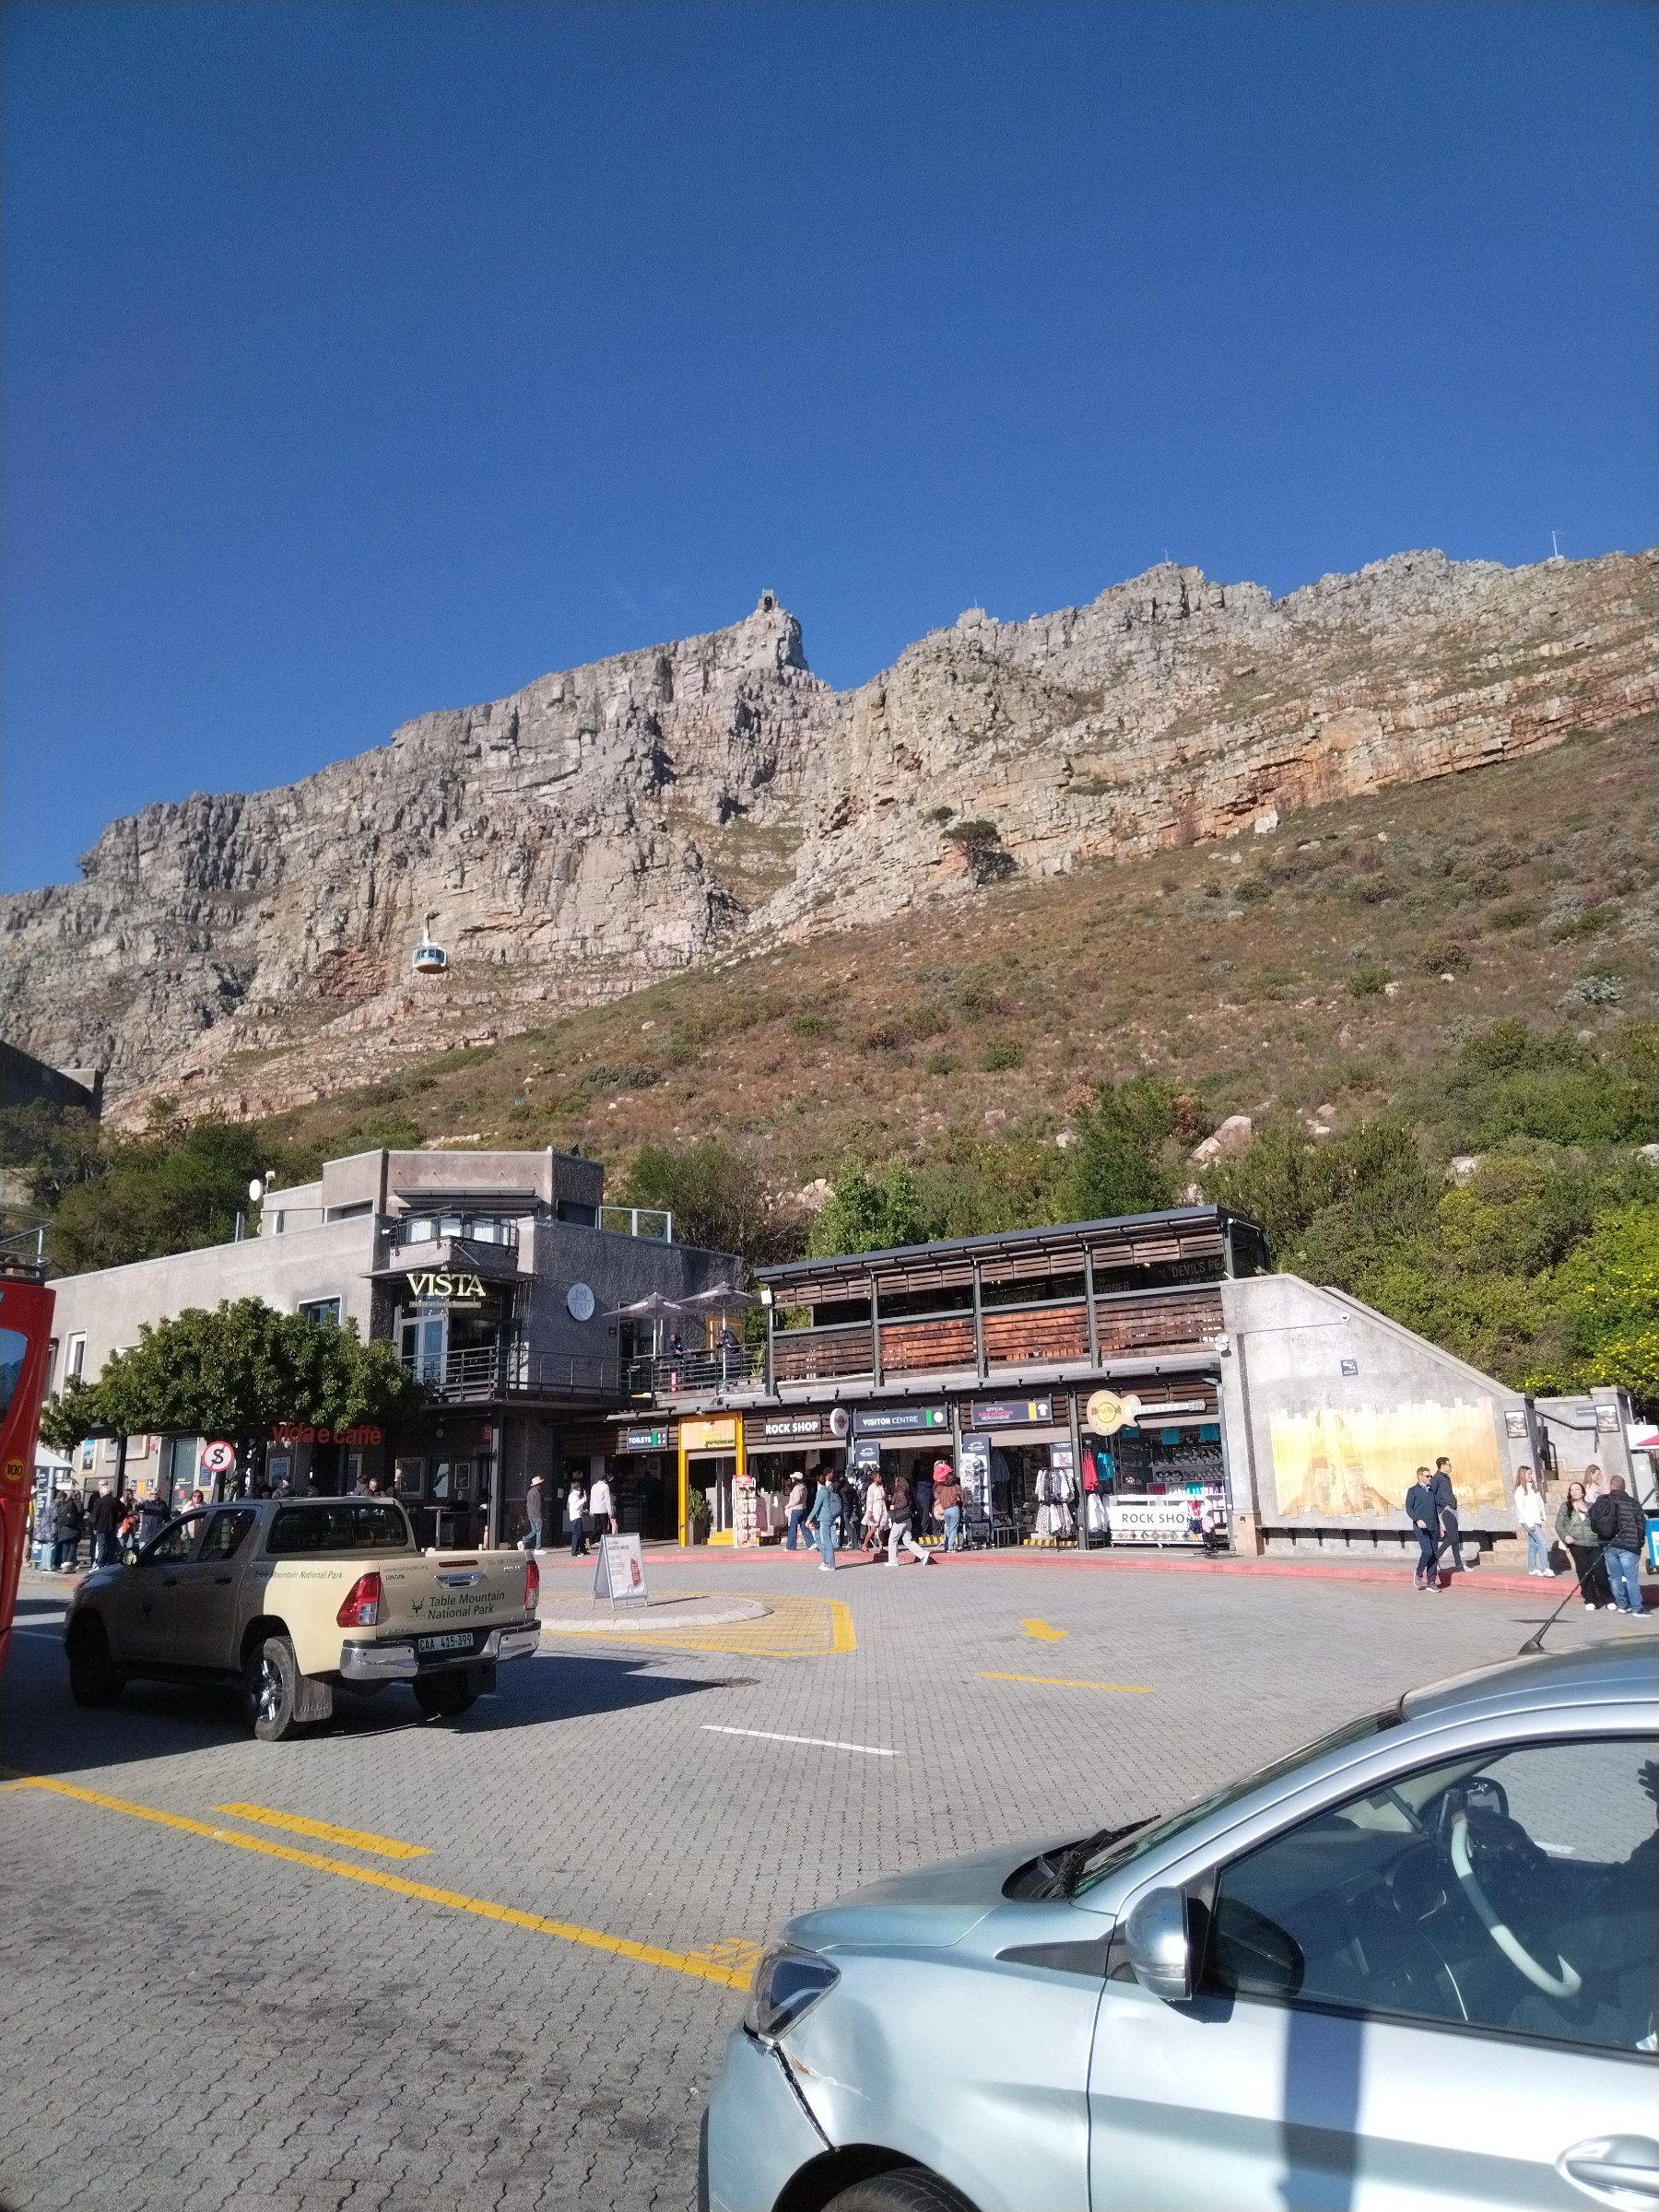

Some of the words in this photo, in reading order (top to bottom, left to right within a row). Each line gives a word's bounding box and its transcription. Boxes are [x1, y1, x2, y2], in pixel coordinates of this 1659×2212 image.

[1171, 1261, 1206, 1277] DEVILS
[1208, 1256, 1225, 1272] PEA
[406, 1273, 487, 1297] VISTA
[765, 1423, 790, 1434] ROCK
[792, 1421, 818, 1432] SHOP
[863, 1418, 891, 1426] VISITOR
[891, 1416, 918, 1424] CENTRE
[317, 1427, 330, 1443] e
[628, 1436, 652, 1444] TOILETS
[6, 1464, 22, 1477] 100
[1122, 1513, 1154, 1524] ROCK
[1159, 1513, 1185, 1524] SHO
[429, 1594, 456, 1606] Table
[459, 1590, 505, 1605] Mountain
[428, 1605, 471, 1619] National
[473, 1604, 494, 1615] Park
[419, 1639, 435, 1651] CAA
[441, 1634, 472, 1648] 415-399
